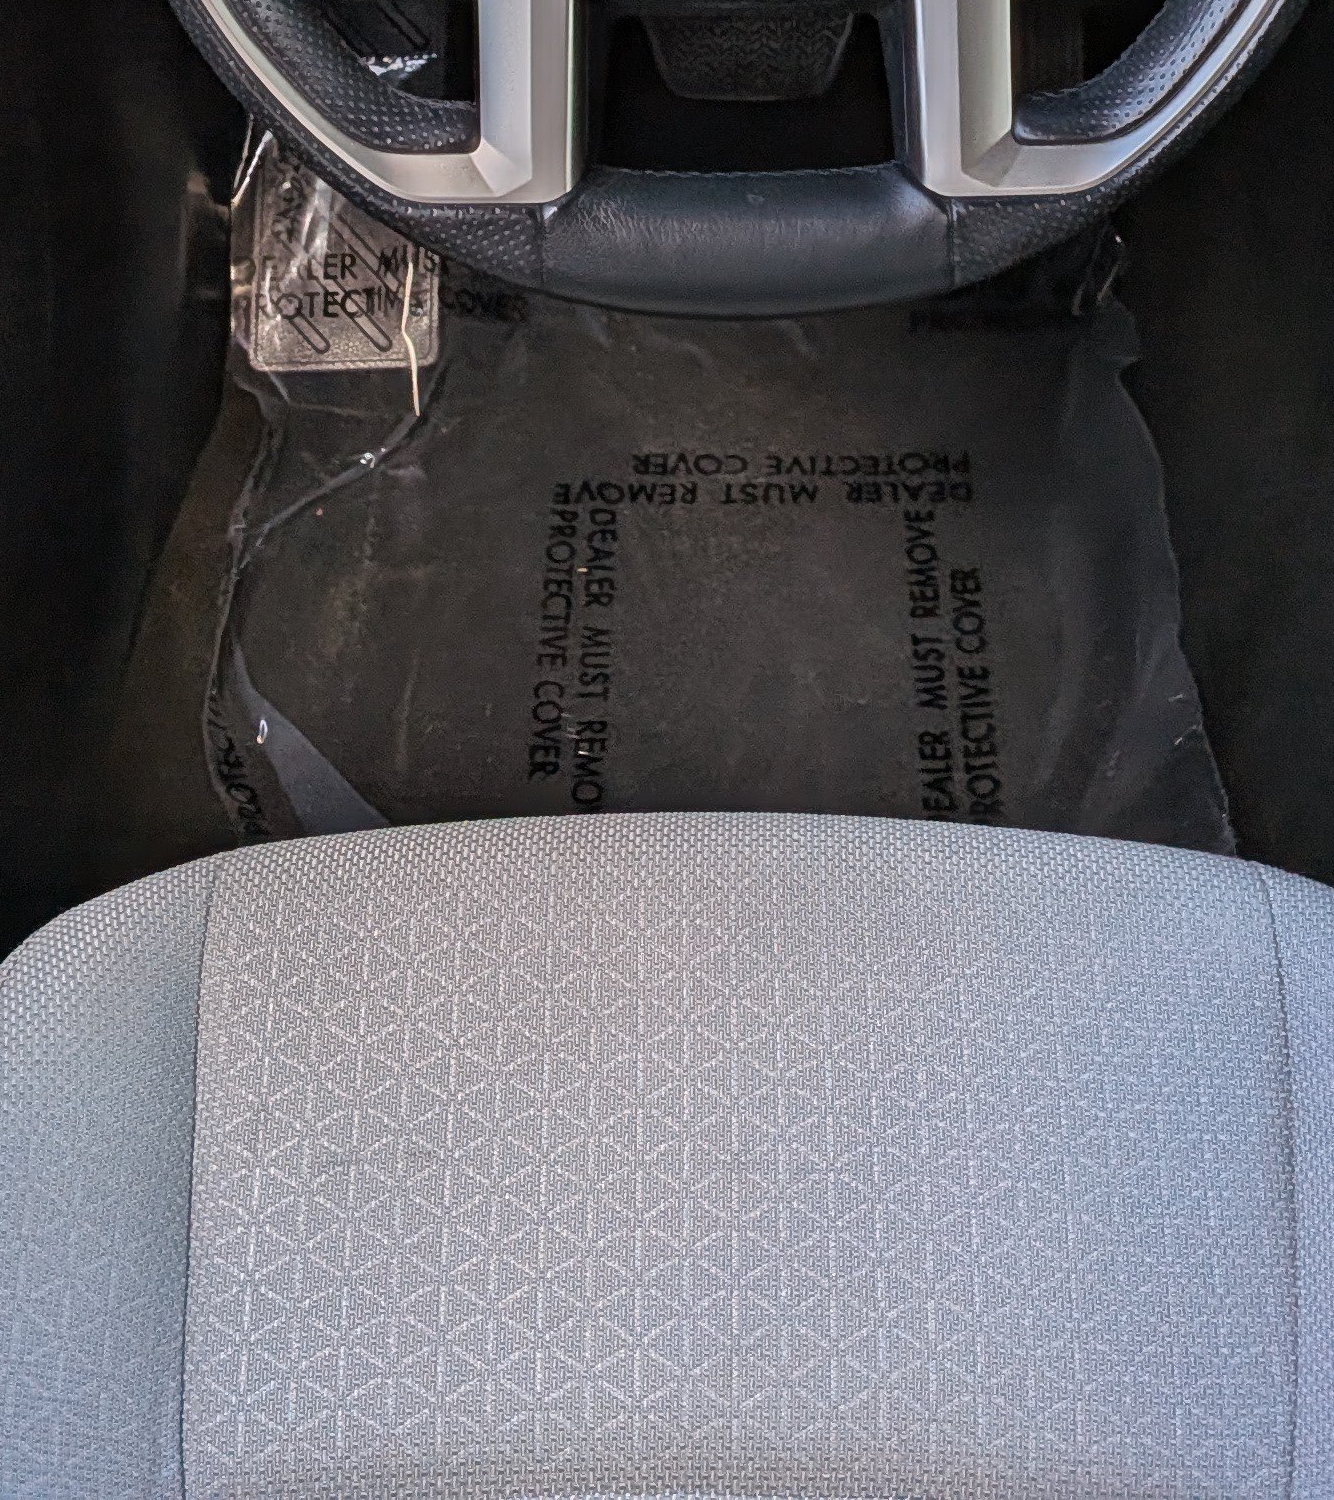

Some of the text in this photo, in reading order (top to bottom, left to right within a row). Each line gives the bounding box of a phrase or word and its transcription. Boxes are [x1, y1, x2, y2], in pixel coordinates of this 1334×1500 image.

[555, 480, 972, 505] DEALER MUST REMOVE
[630, 452, 970, 477] PROTECTIVE COVER
[584, 507, 618, 608] DEALER
[904, 508, 941, 619] REMOVE
[527, 507, 579, 782] PROTECTIVE COVER
[950, 567, 988, 654] COVER
[577, 625, 611, 701] MUST
[911, 632, 949, 711] MUST
